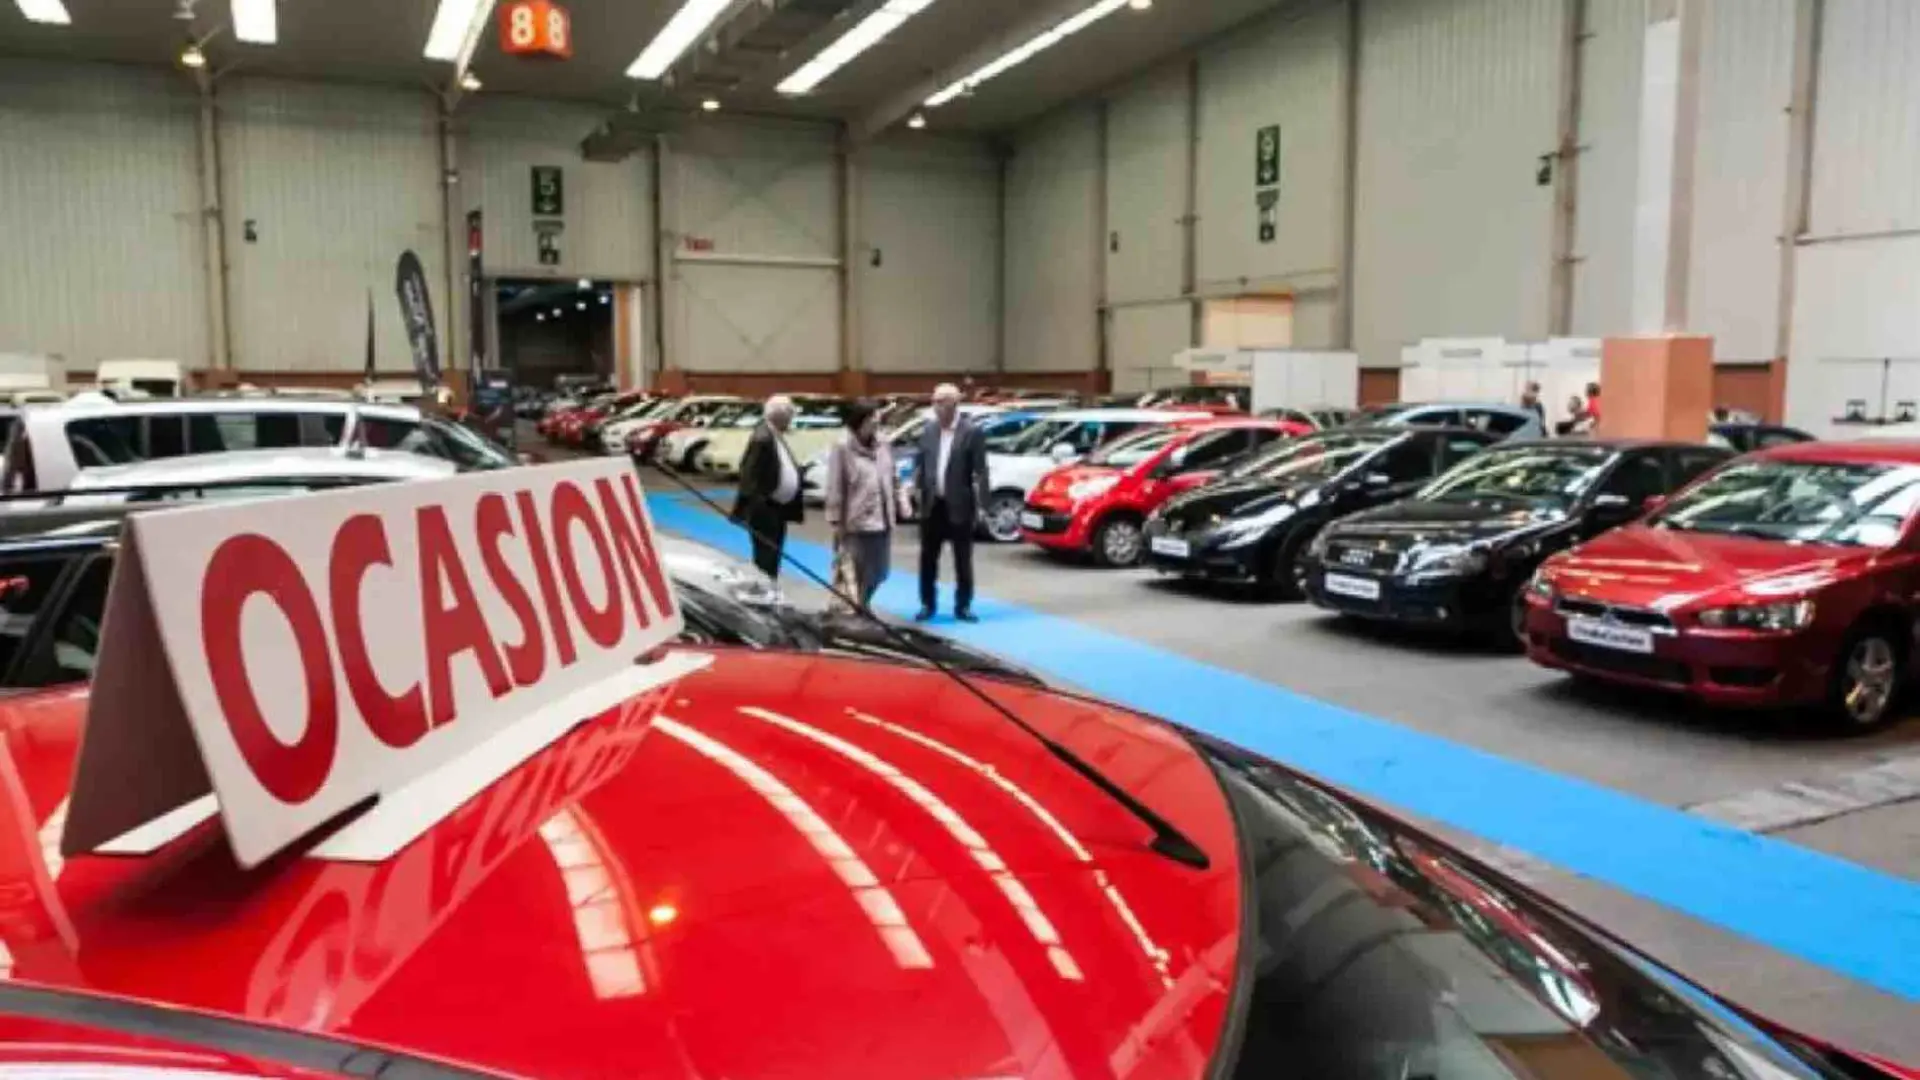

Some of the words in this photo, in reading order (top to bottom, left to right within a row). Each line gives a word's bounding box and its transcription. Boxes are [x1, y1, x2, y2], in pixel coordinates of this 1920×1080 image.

[511, 5, 534, 45] 8
[548, 8, 566, 49] 8
[201, 474, 674, 805] OCASION
